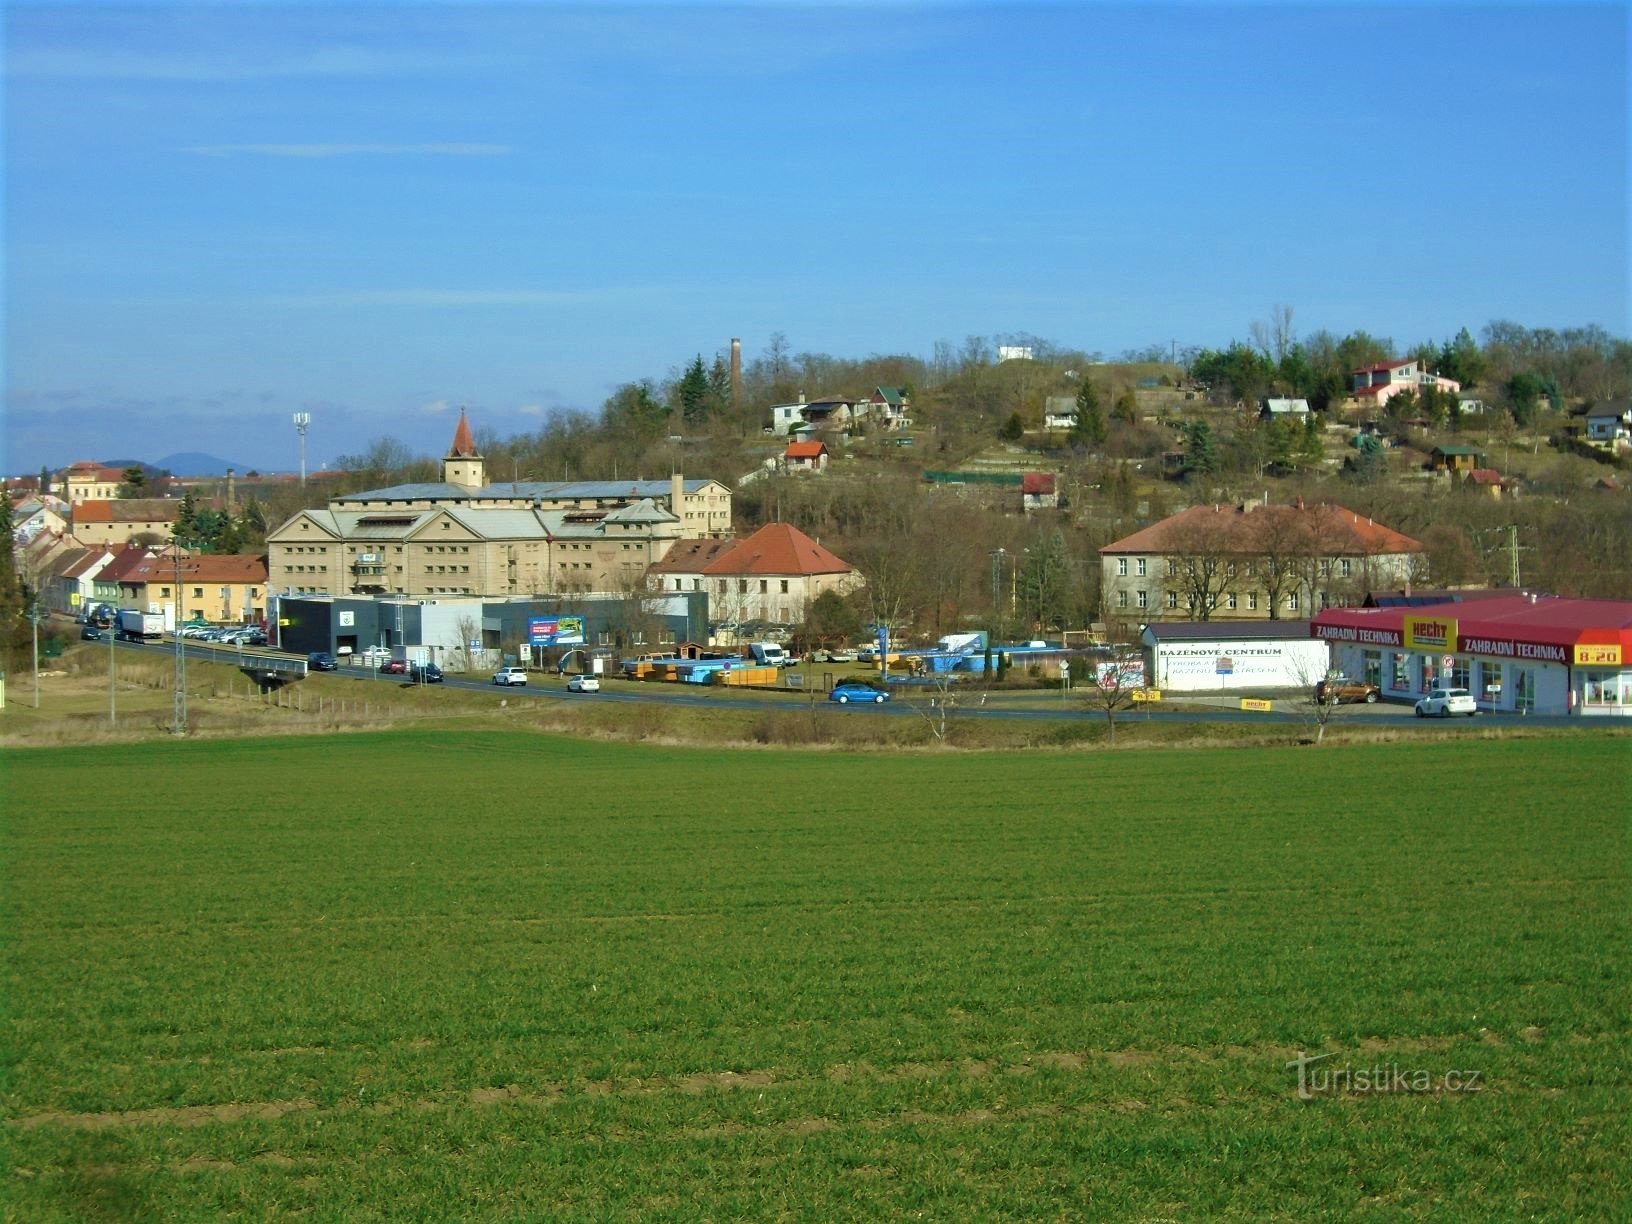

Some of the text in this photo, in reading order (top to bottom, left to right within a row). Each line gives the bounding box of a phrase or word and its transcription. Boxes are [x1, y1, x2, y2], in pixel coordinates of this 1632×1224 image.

[1316, 625, 1357, 640] ZAHRADNÍ
[1359, 629, 1399, 645] TECHNIKA
[1464, 639, 1514, 656] ZAHRADNÍ
[1516, 643, 1566, 661] TECHNIKA
